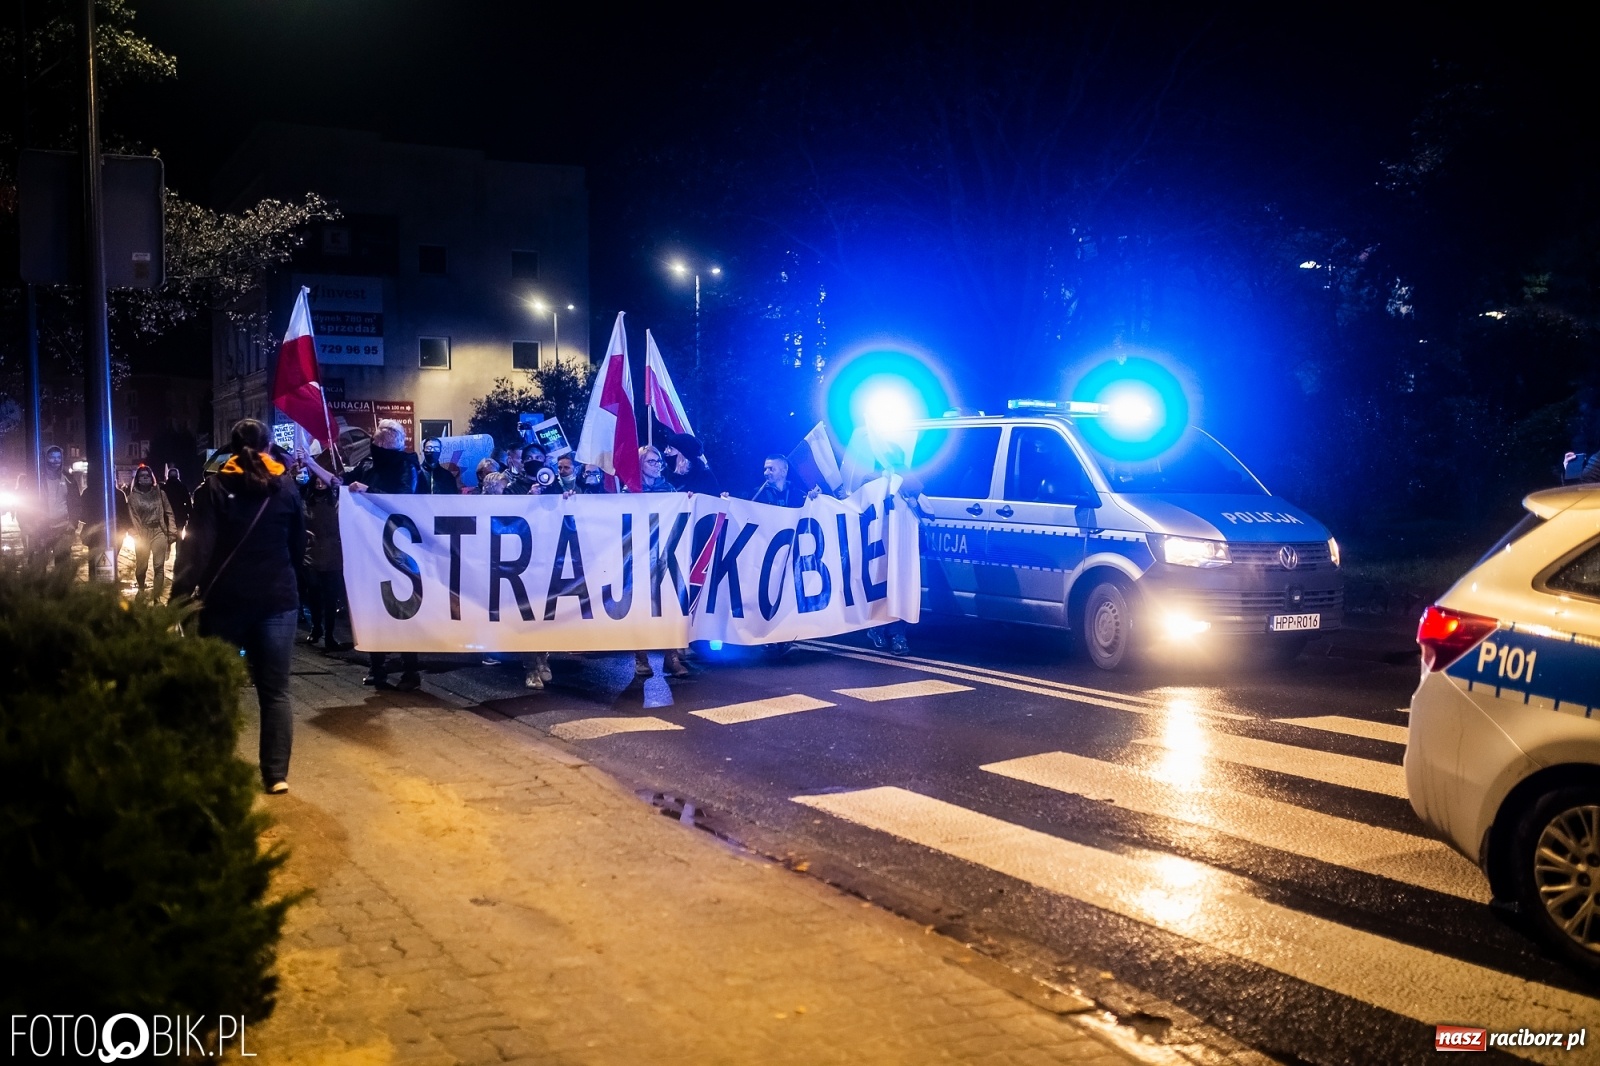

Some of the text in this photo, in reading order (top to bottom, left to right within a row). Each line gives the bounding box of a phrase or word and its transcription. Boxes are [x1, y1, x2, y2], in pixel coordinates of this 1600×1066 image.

[313, 313, 342, 323] dynek
[320, 324, 377, 333] sprzedaż
[320, 344, 378, 355] 729 96 95
[327, 401, 371, 410] AURACJA
[1221, 511, 1304, 524] POLICJA
[380, 496, 894, 622] STRAJK KOBIE
[1478, 641, 1537, 682] P101
